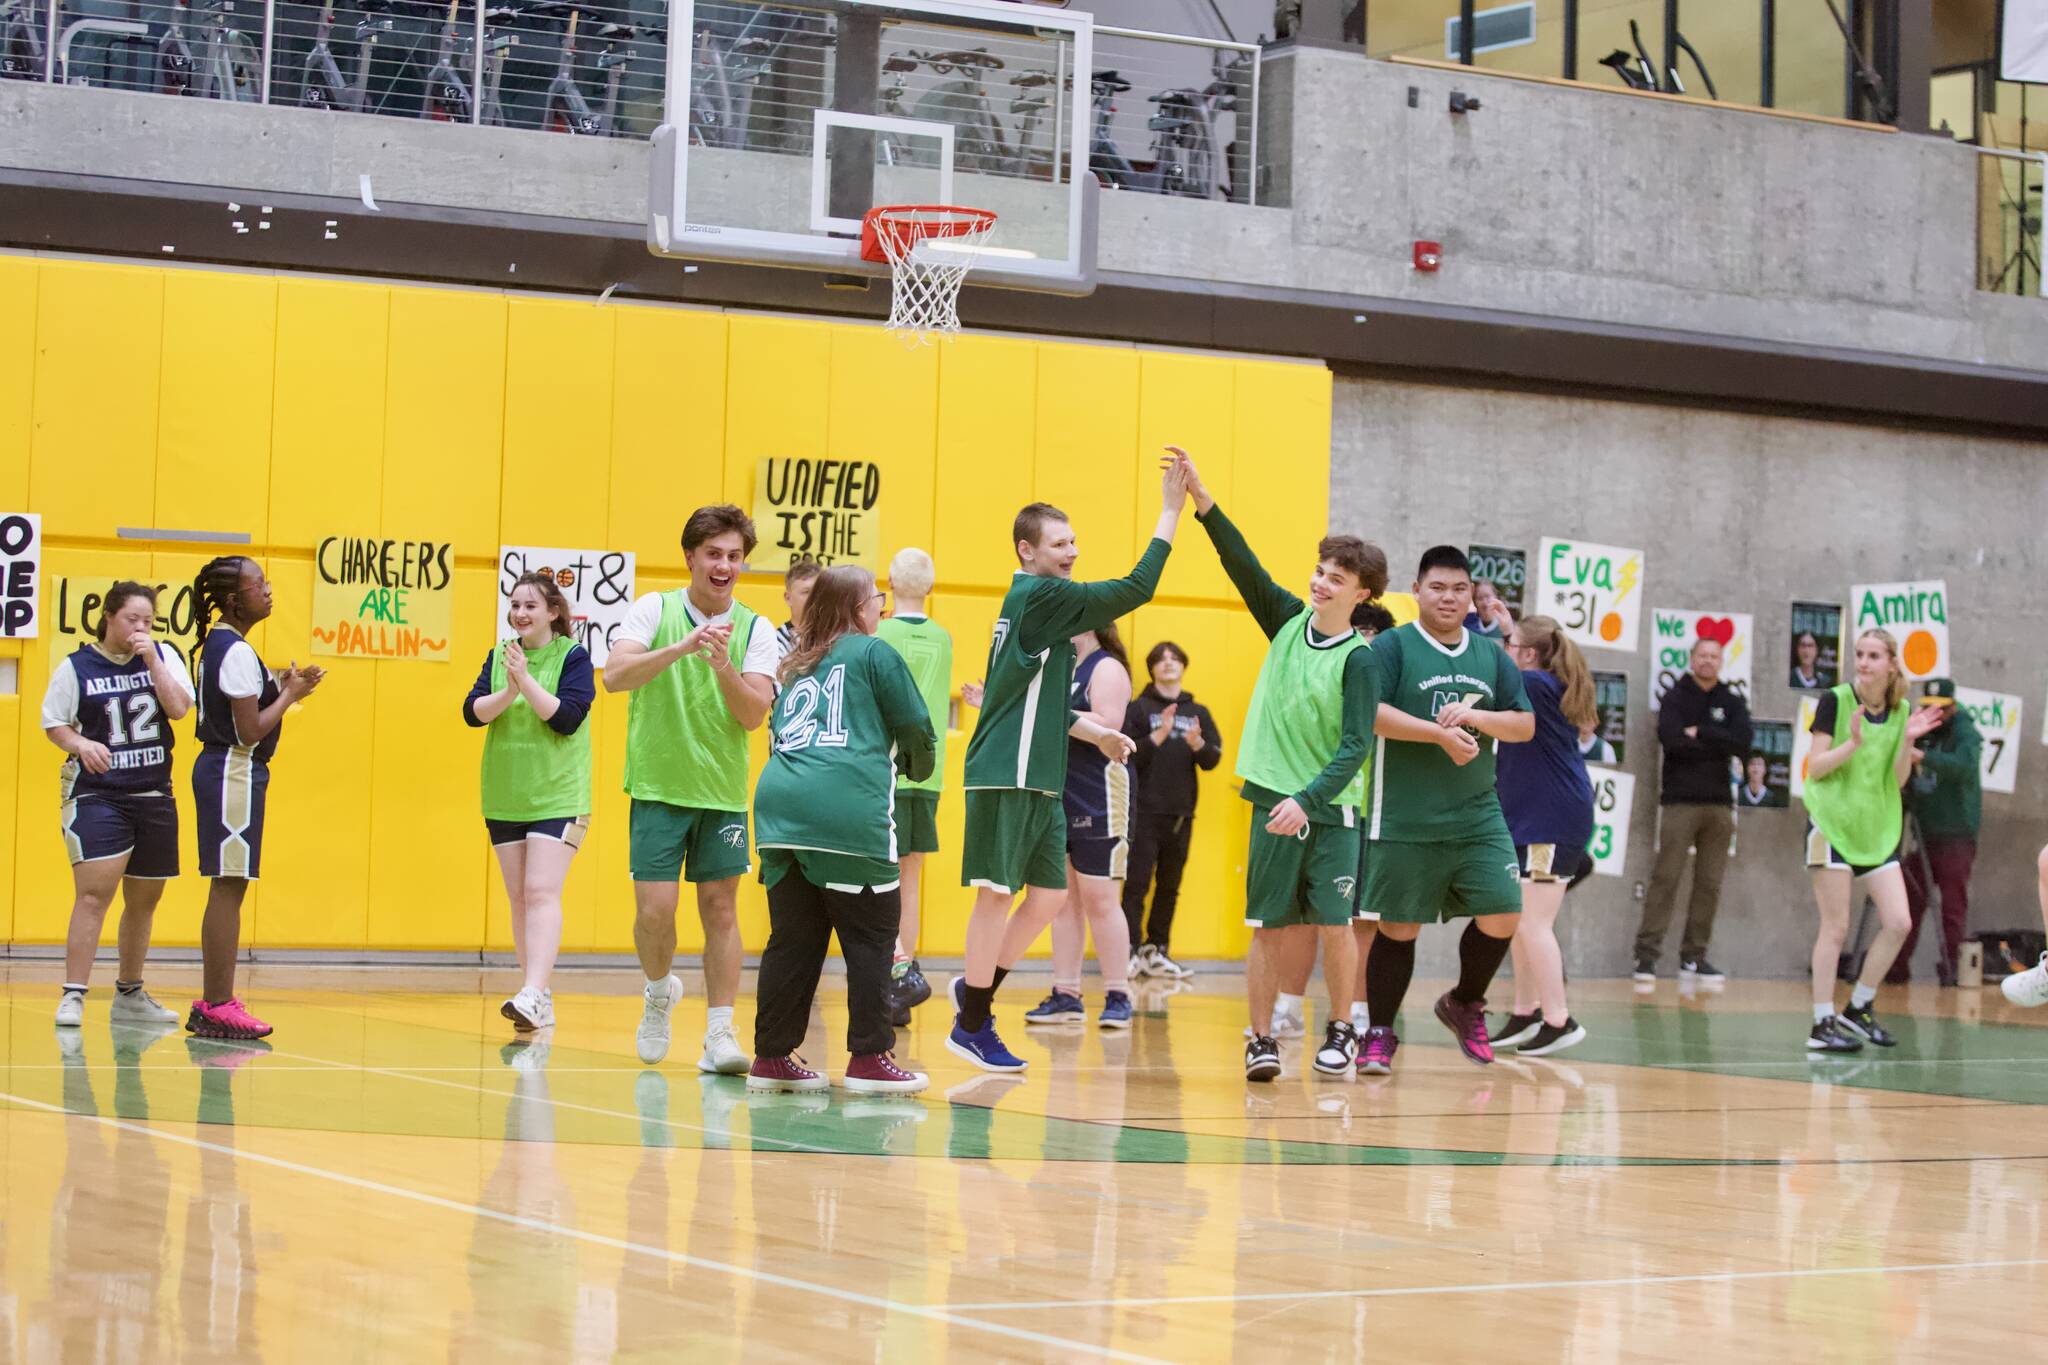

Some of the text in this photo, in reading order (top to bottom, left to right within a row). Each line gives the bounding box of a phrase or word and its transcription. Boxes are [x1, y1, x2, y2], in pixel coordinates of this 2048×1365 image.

[766, 457, 880, 511] UNIFIED
[776, 510, 862, 556] IS THE
[0, 561, 35, 597] E
[318, 536, 452, 590] CHARGERS
[593, 552, 629, 606] &
[1470, 553, 1525, 586] 2026
[1550, 543, 1613, 592] Eva
[0, 600, 34, 636] P
[358, 588, 409, 624] ARE
[1656, 613, 1686, 638] We
[1858, 584, 1948, 627] Amira
[1418, 674, 1453, 691] Unified
[103, 692, 161, 747] 12
[775, 663, 849, 752] 21
[109, 746, 165, 770] UNIFIED
